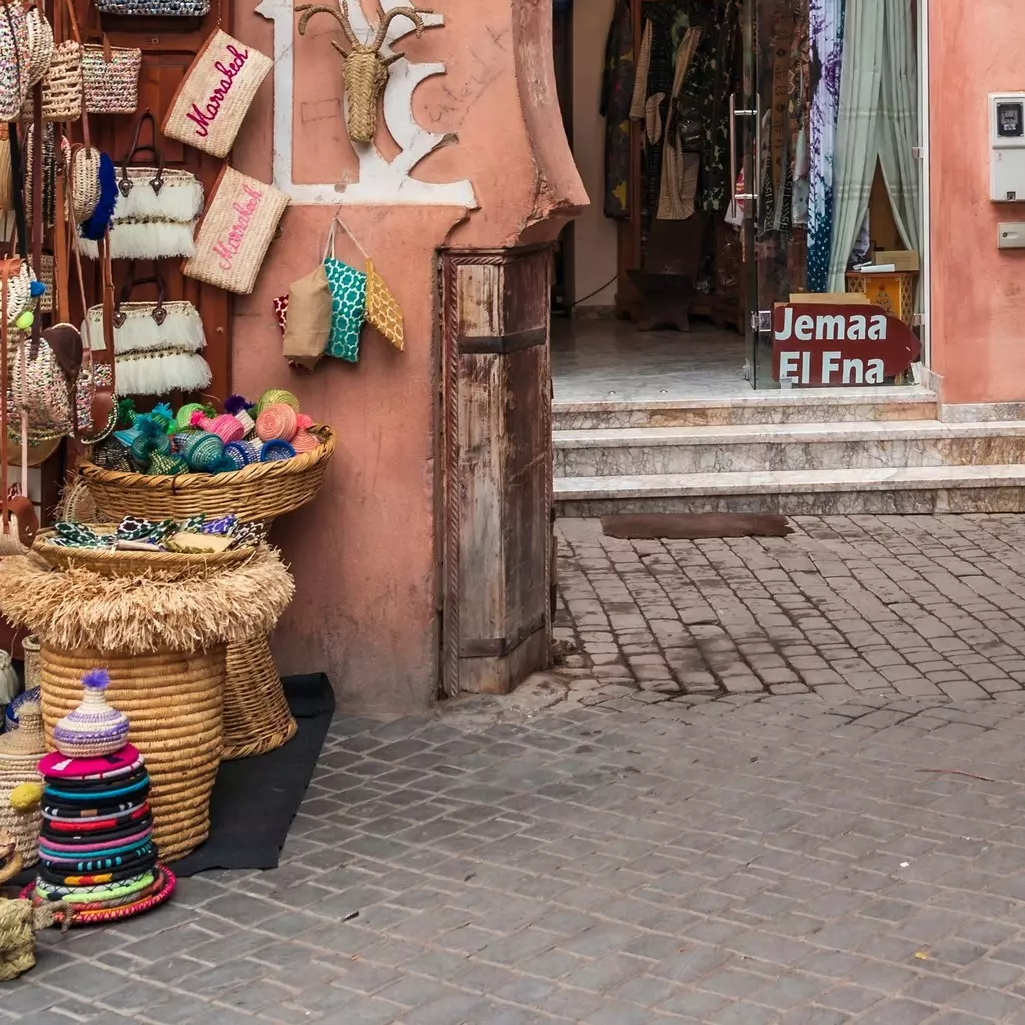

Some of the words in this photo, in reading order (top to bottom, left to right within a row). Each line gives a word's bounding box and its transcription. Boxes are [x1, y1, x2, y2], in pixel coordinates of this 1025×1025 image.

[186, 44, 248, 138] Marrakech
[775, 307, 887, 340] Jemaa
[779, 351, 810, 384] El
[822, 351, 885, 384] Fna
